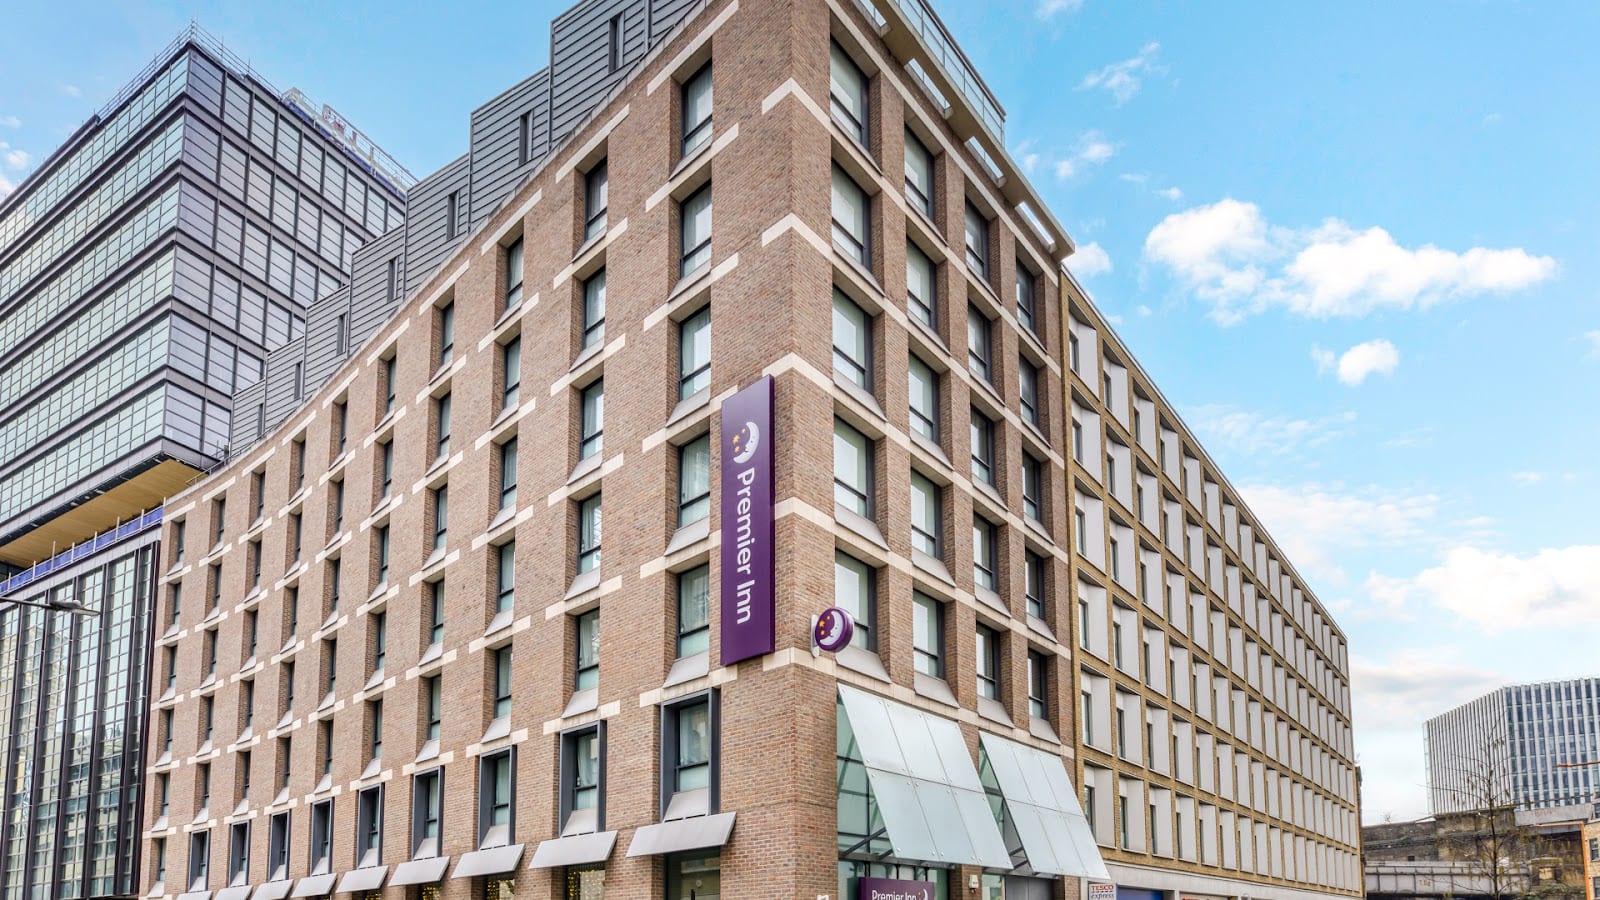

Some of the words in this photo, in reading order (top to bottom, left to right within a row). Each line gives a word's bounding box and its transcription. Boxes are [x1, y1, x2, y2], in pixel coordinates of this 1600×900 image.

[737, 467, 755, 575] Premier
[737, 580, 755, 624] Inn
[871, 889, 904, 900] Premier
[905, 892, 917, 900] Inn
